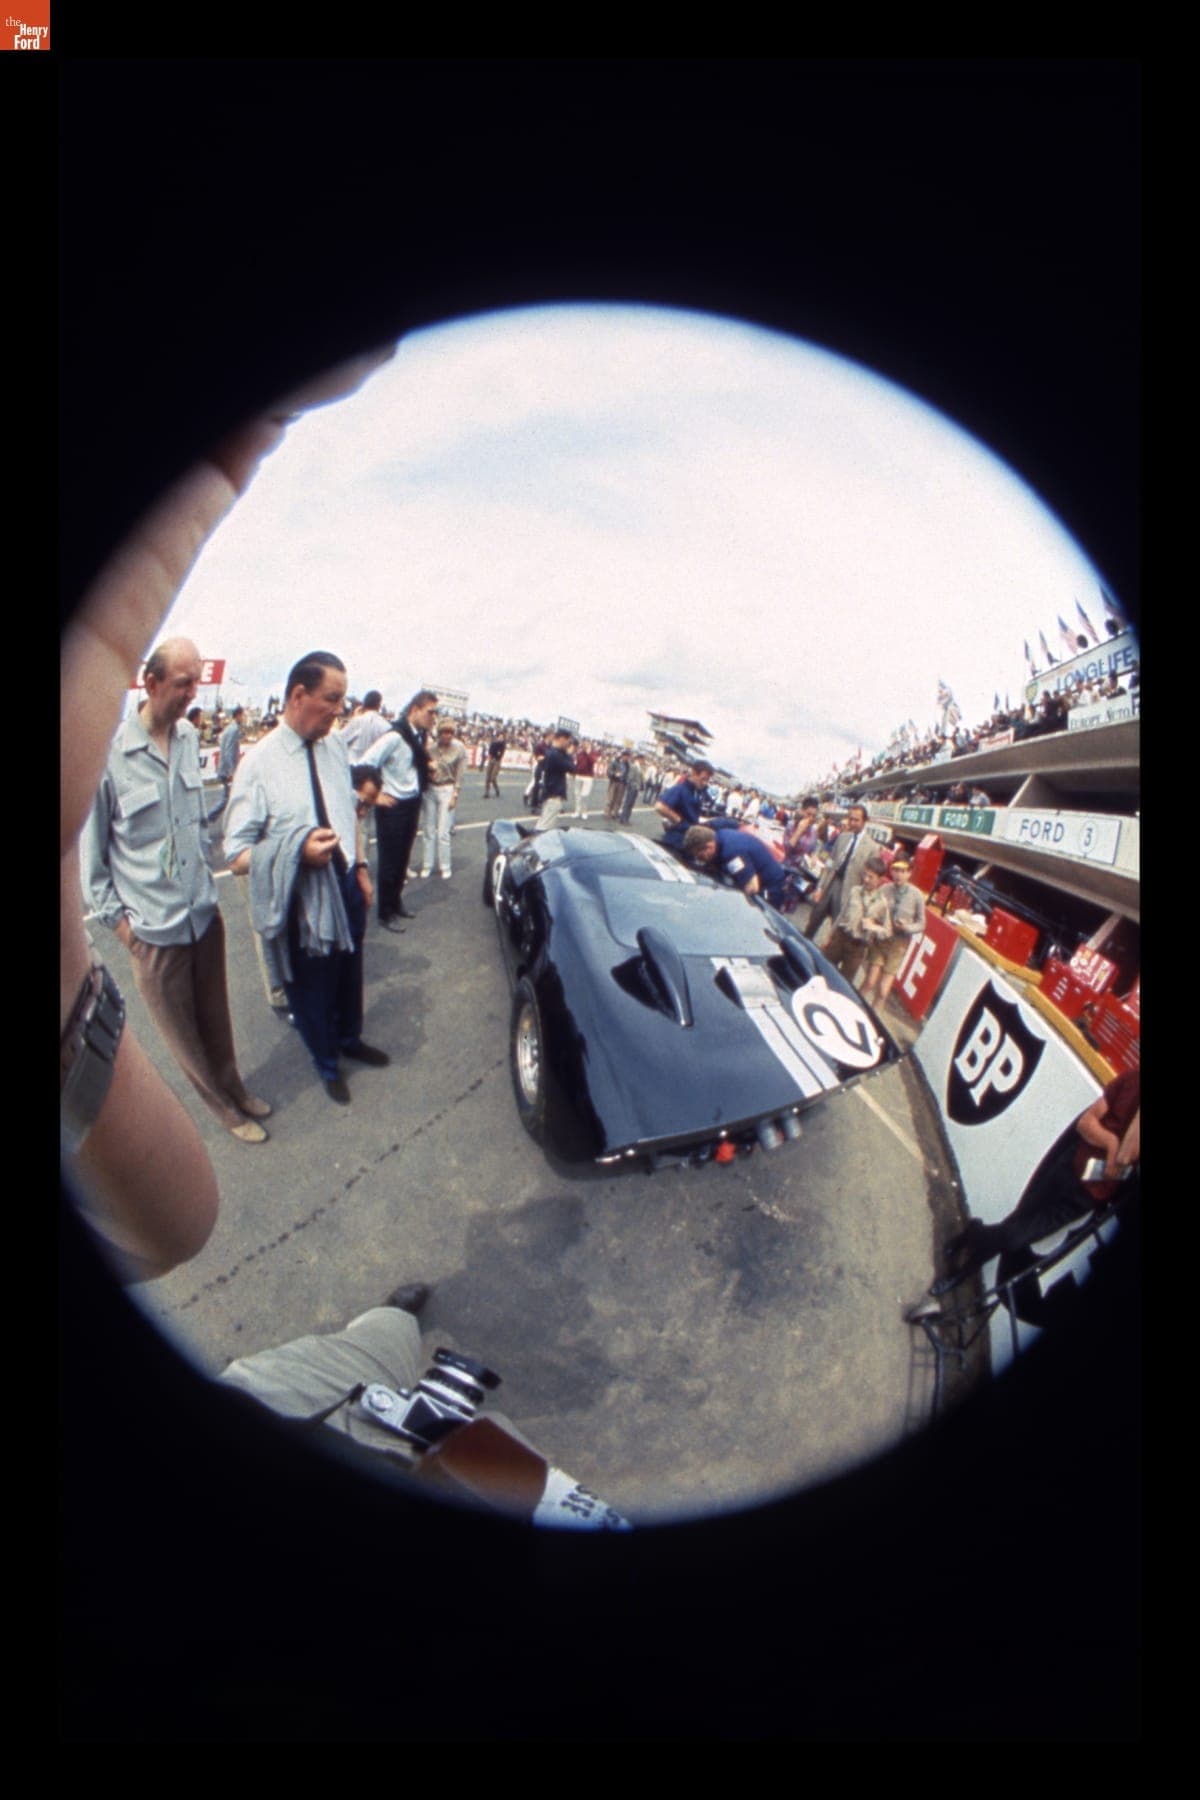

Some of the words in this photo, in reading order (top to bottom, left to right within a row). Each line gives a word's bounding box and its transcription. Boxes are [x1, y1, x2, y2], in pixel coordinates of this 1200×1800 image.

[943, 812, 968, 829] FORD
[1019, 818, 1065, 843] FORD
[1084, 828, 1093, 847] 3
[803, 1002, 873, 1057] 2
[954, 1006, 1024, 1107] BP
